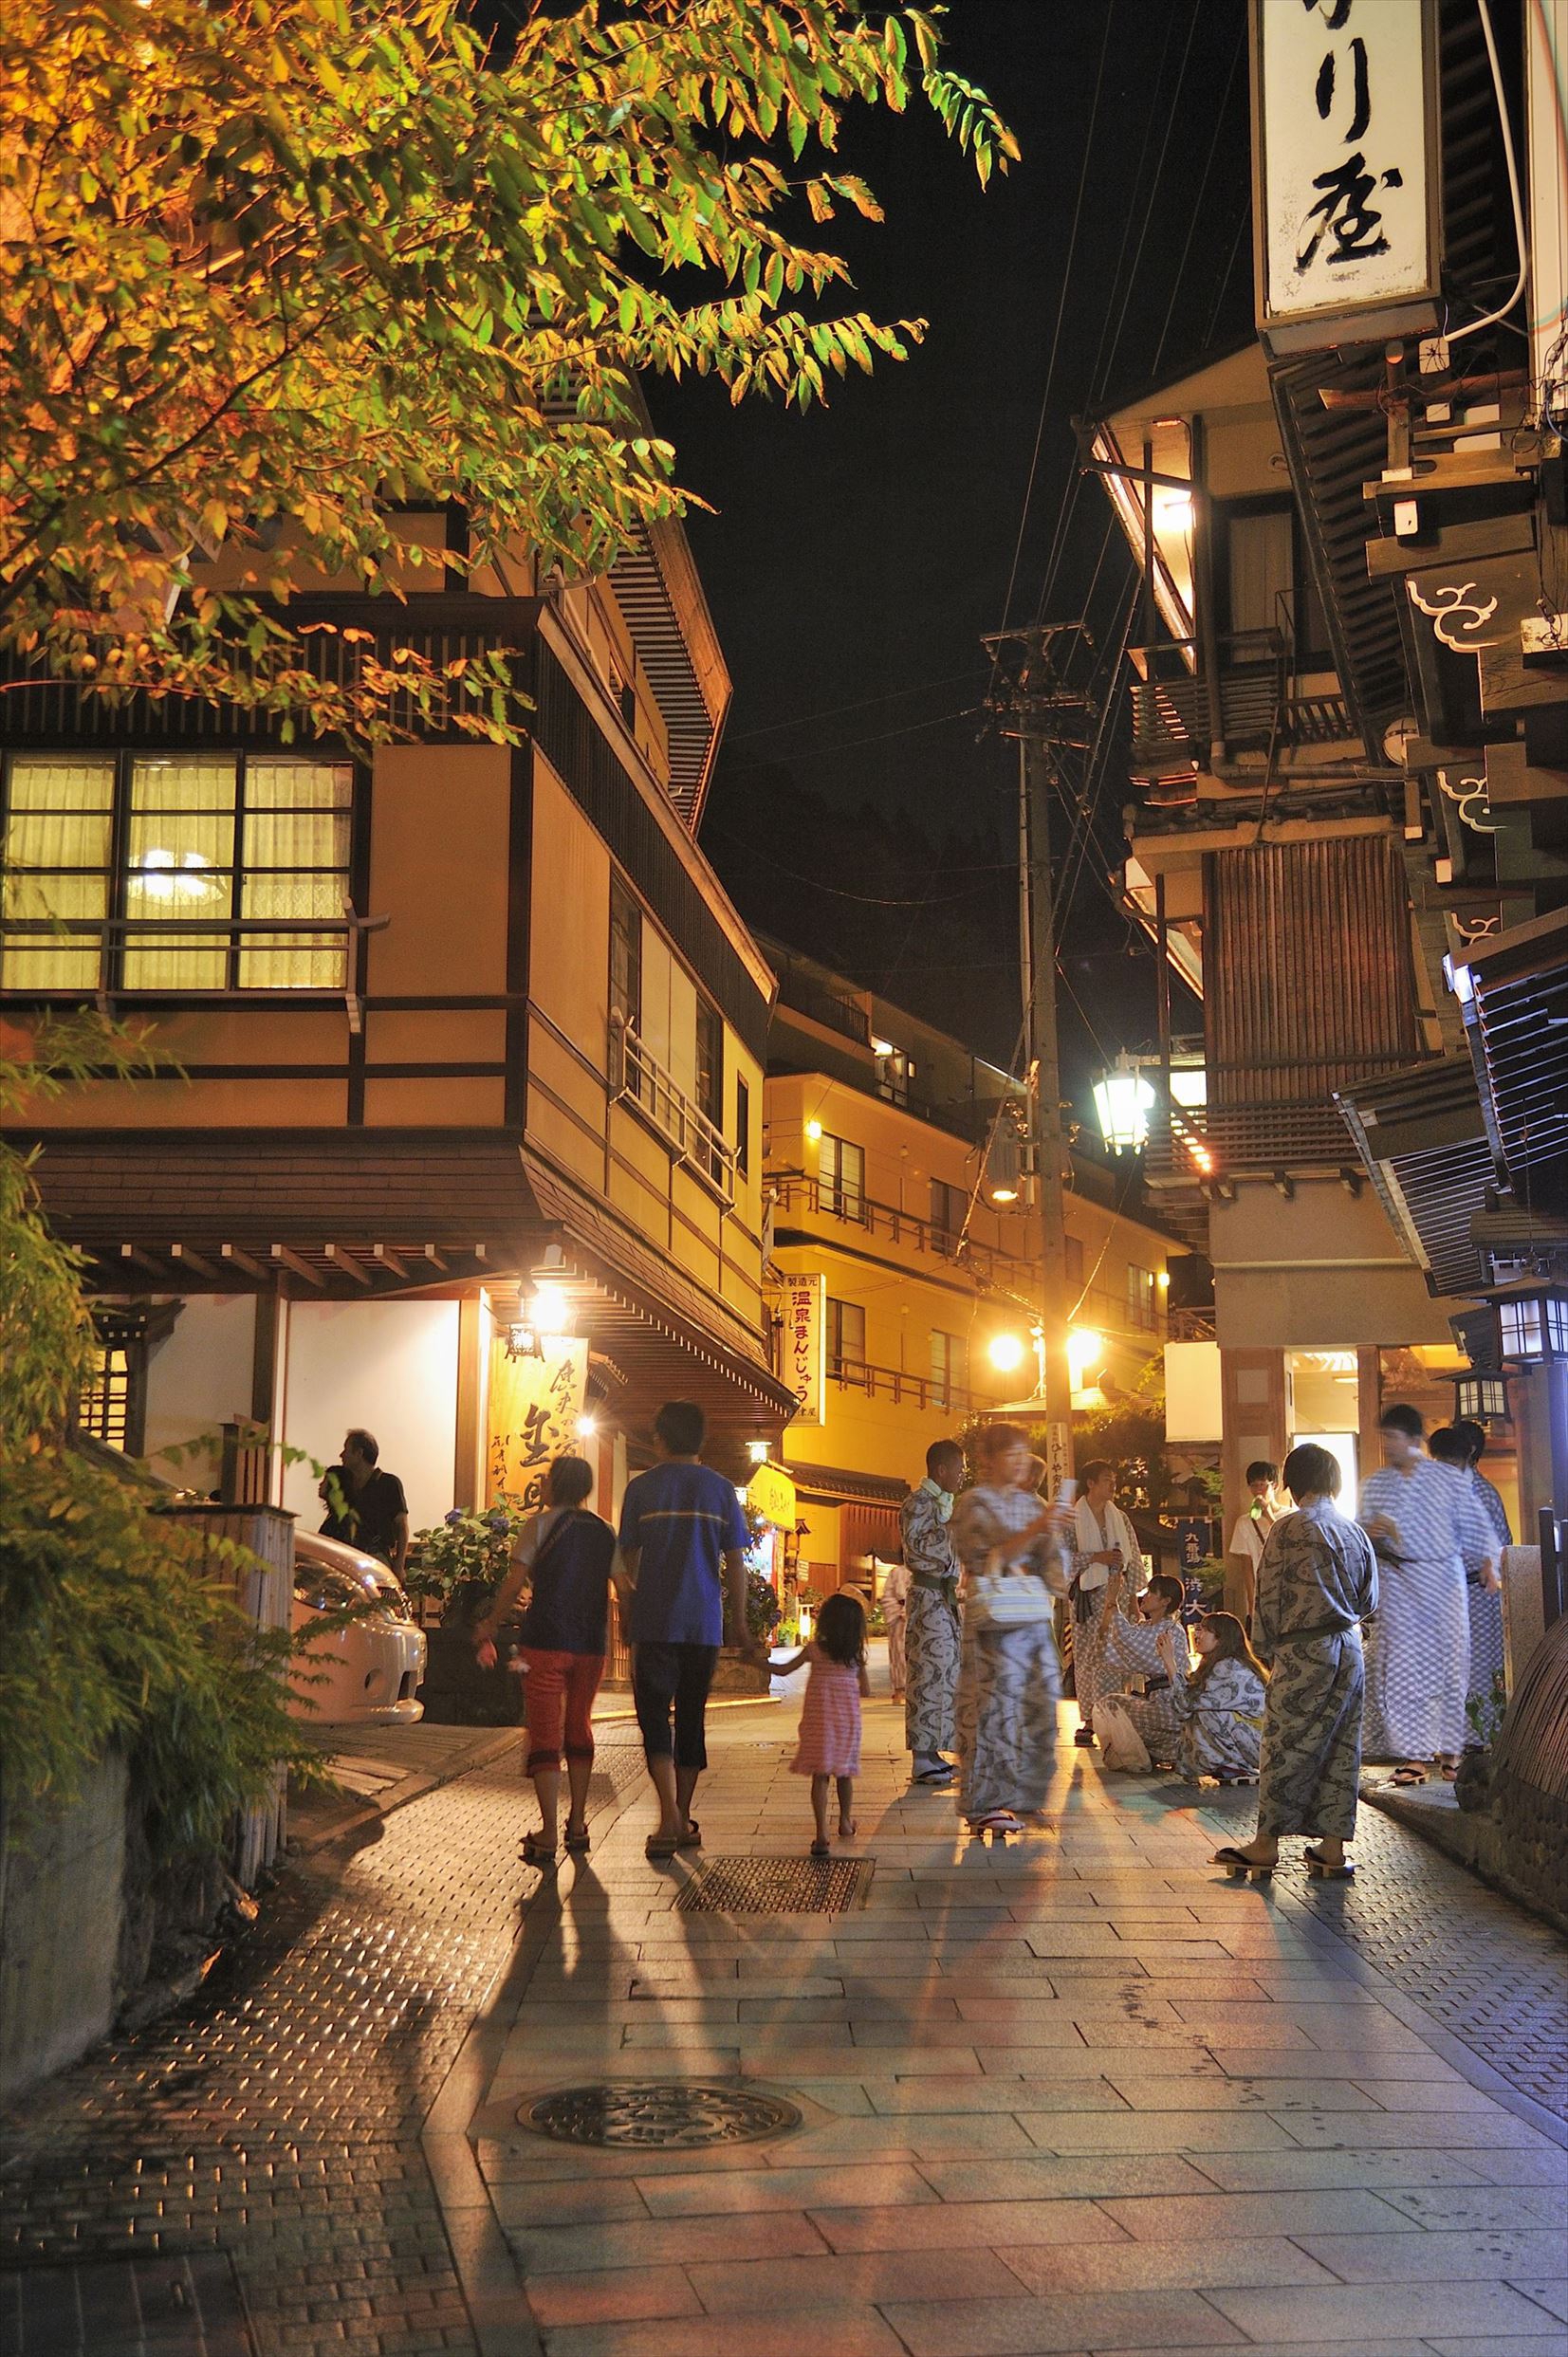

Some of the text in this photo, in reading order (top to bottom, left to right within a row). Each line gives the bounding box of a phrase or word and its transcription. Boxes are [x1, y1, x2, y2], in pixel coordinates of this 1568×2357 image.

[788, 1276, 818, 1287] 製造元
[791, 1291, 812, 1403] 温泉まんじゅう
